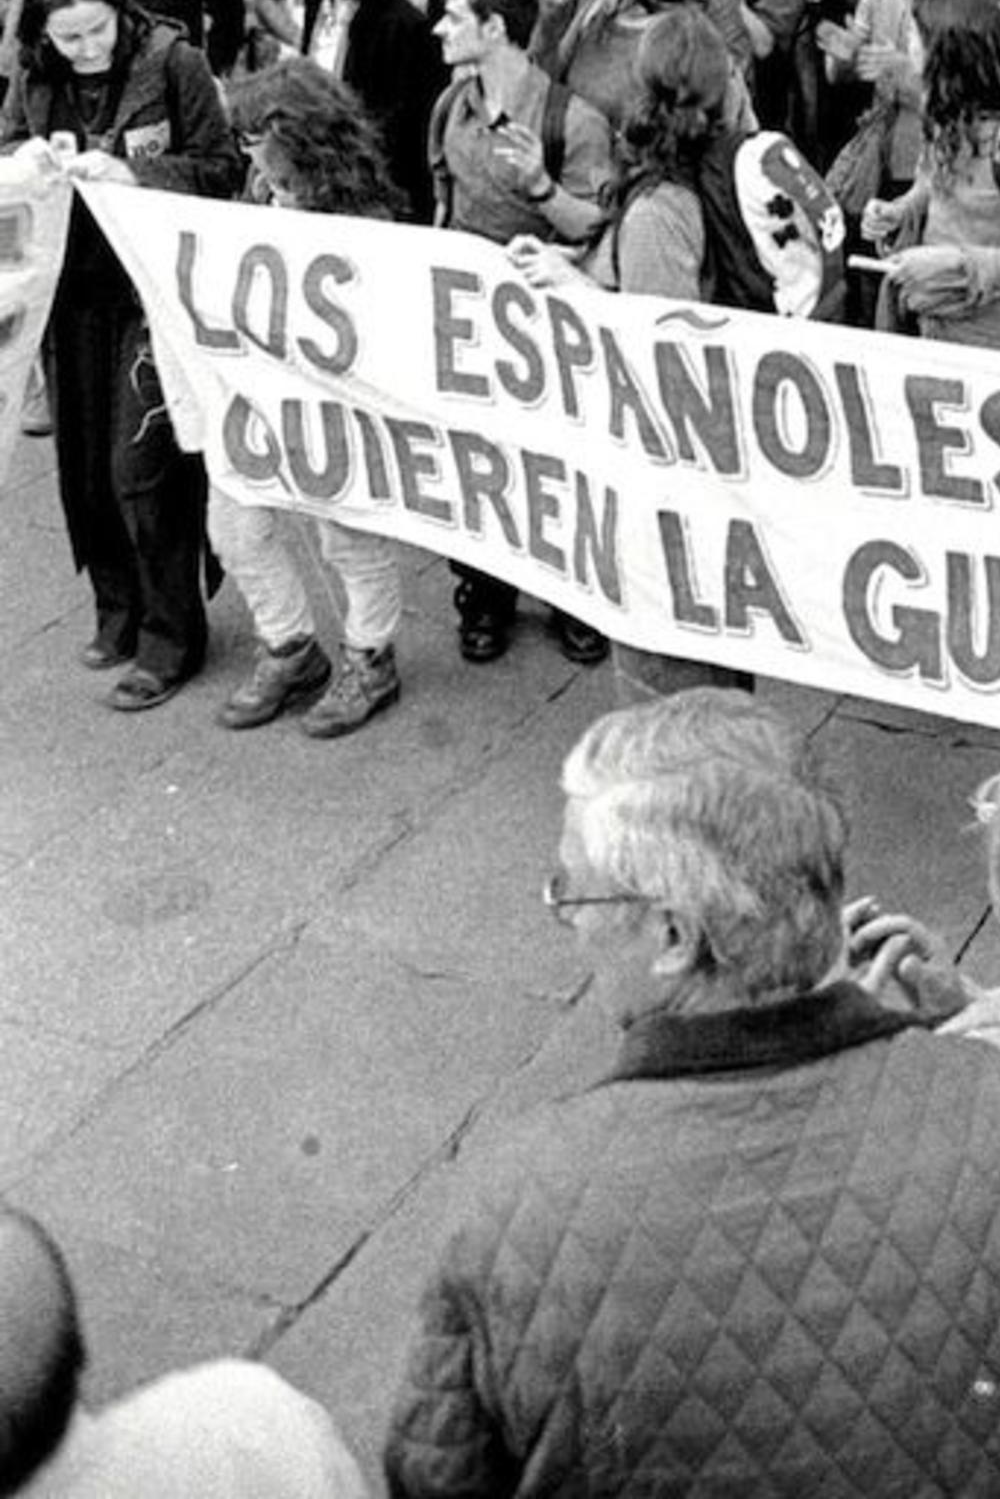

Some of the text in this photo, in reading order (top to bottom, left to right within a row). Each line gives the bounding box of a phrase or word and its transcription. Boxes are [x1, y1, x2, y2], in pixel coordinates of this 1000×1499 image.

[176, 230, 362, 377] LOS
[222, 393, 626, 607] QUIEREN
[657, 508, 813, 652] LA
